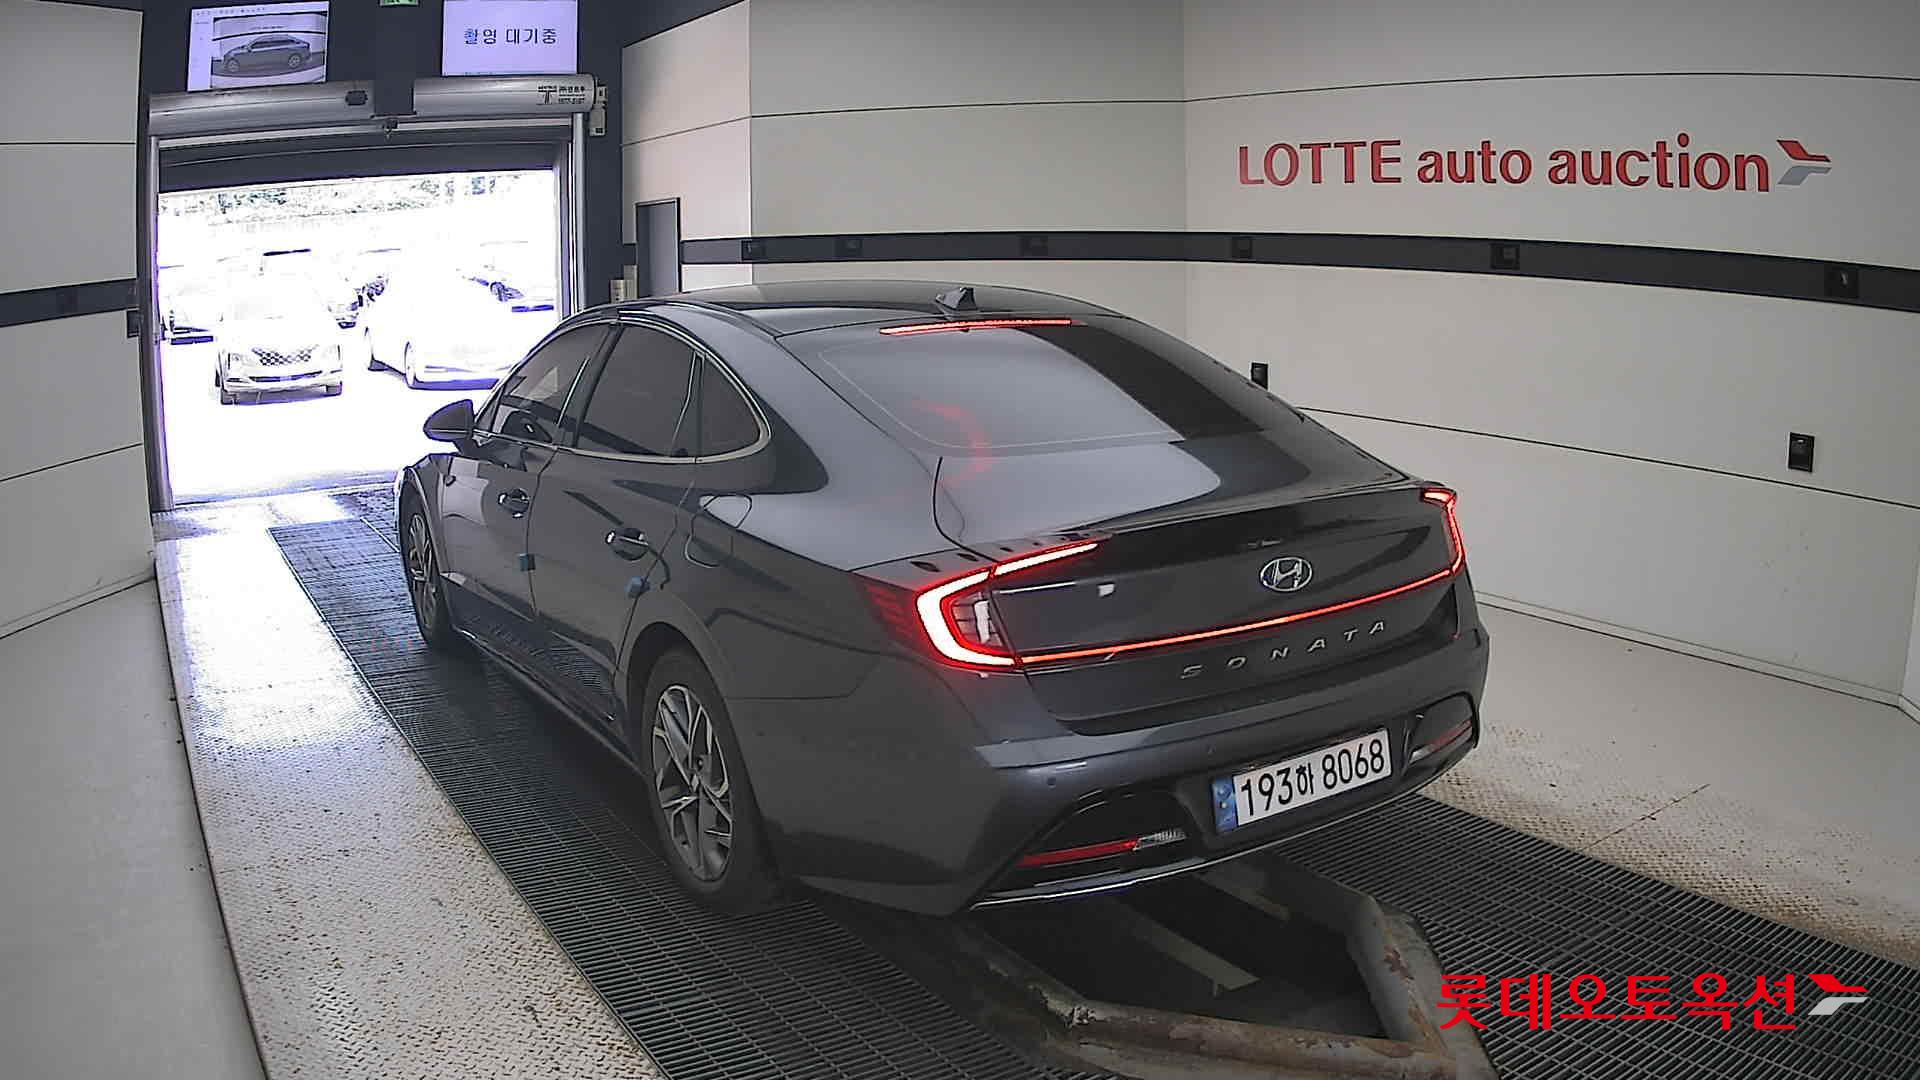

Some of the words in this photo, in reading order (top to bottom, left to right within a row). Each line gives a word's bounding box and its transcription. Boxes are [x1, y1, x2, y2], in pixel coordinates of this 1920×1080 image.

[505, 28, 557, 45] 대기중
[1239, 139, 1401, 186] LOTTE
[1417, 140, 1532, 184] auto
[1548, 132, 1769, 192] auction
[1180, 620, 1385, 680] SONATA
[1240, 762, 1314, 816] 193하
[1321, 738, 1385, 790] 8068
